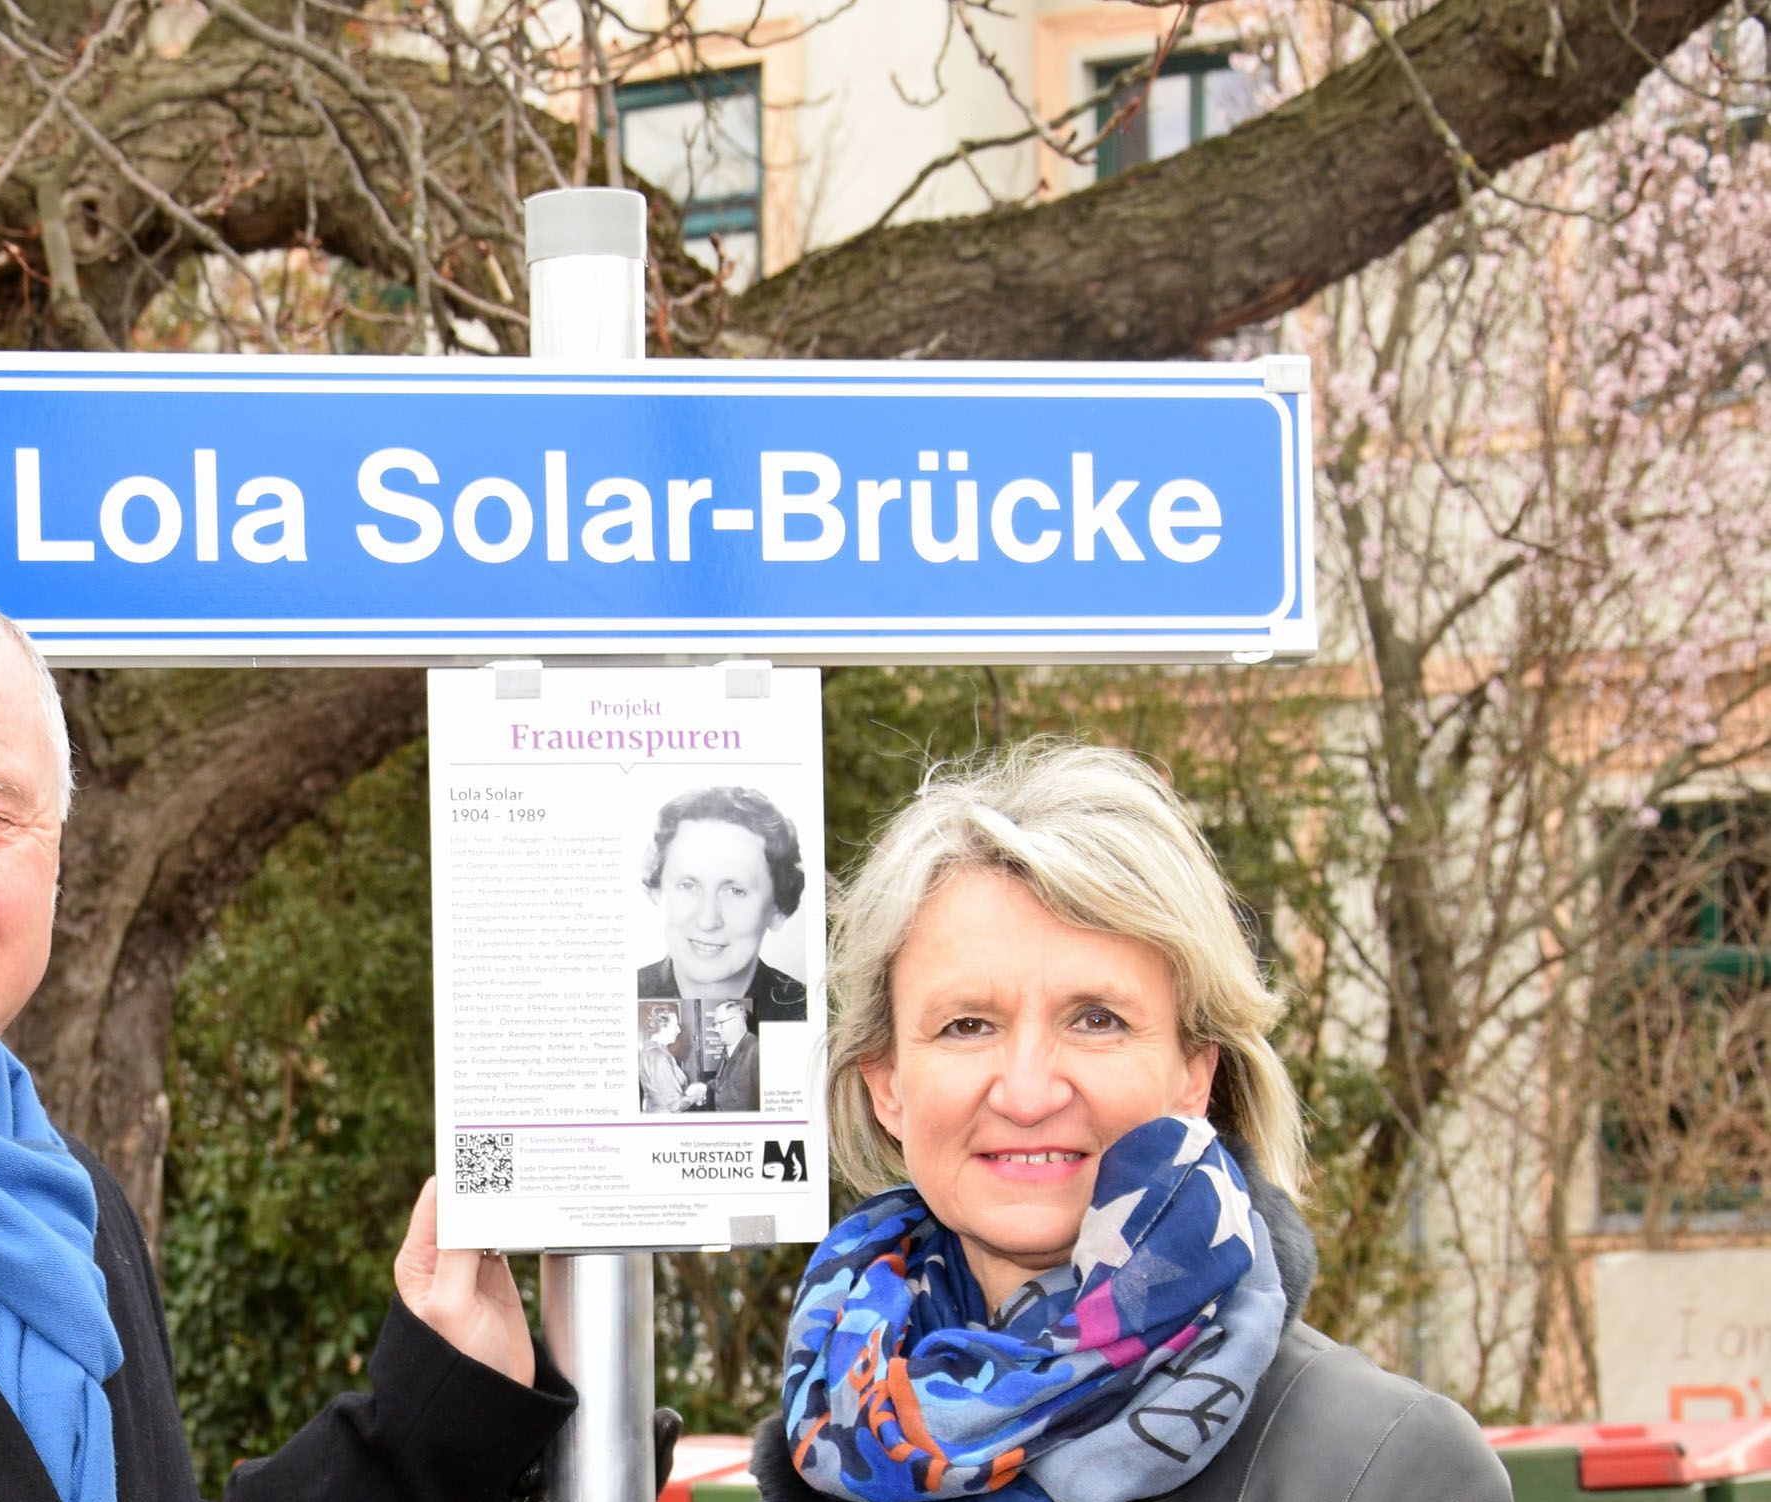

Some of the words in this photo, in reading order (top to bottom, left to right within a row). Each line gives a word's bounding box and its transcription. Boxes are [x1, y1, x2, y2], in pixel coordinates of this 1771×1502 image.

[15, 447, 308, 564] Lola
[356, 447, 1222, 564] Solar-Brücke
[590, 699, 662, 720] Projekt
[510, 724, 742, 758] Frauenspuren
[450, 787, 482, 801] Lola
[485, 787, 524, 801] Solar
[451, 808, 490, 822] 1904
[508, 808, 546, 822] 1989
[652, 1151, 754, 1164] KULTURSTADT
[681, 1164, 754, 1180] MÖDLING
